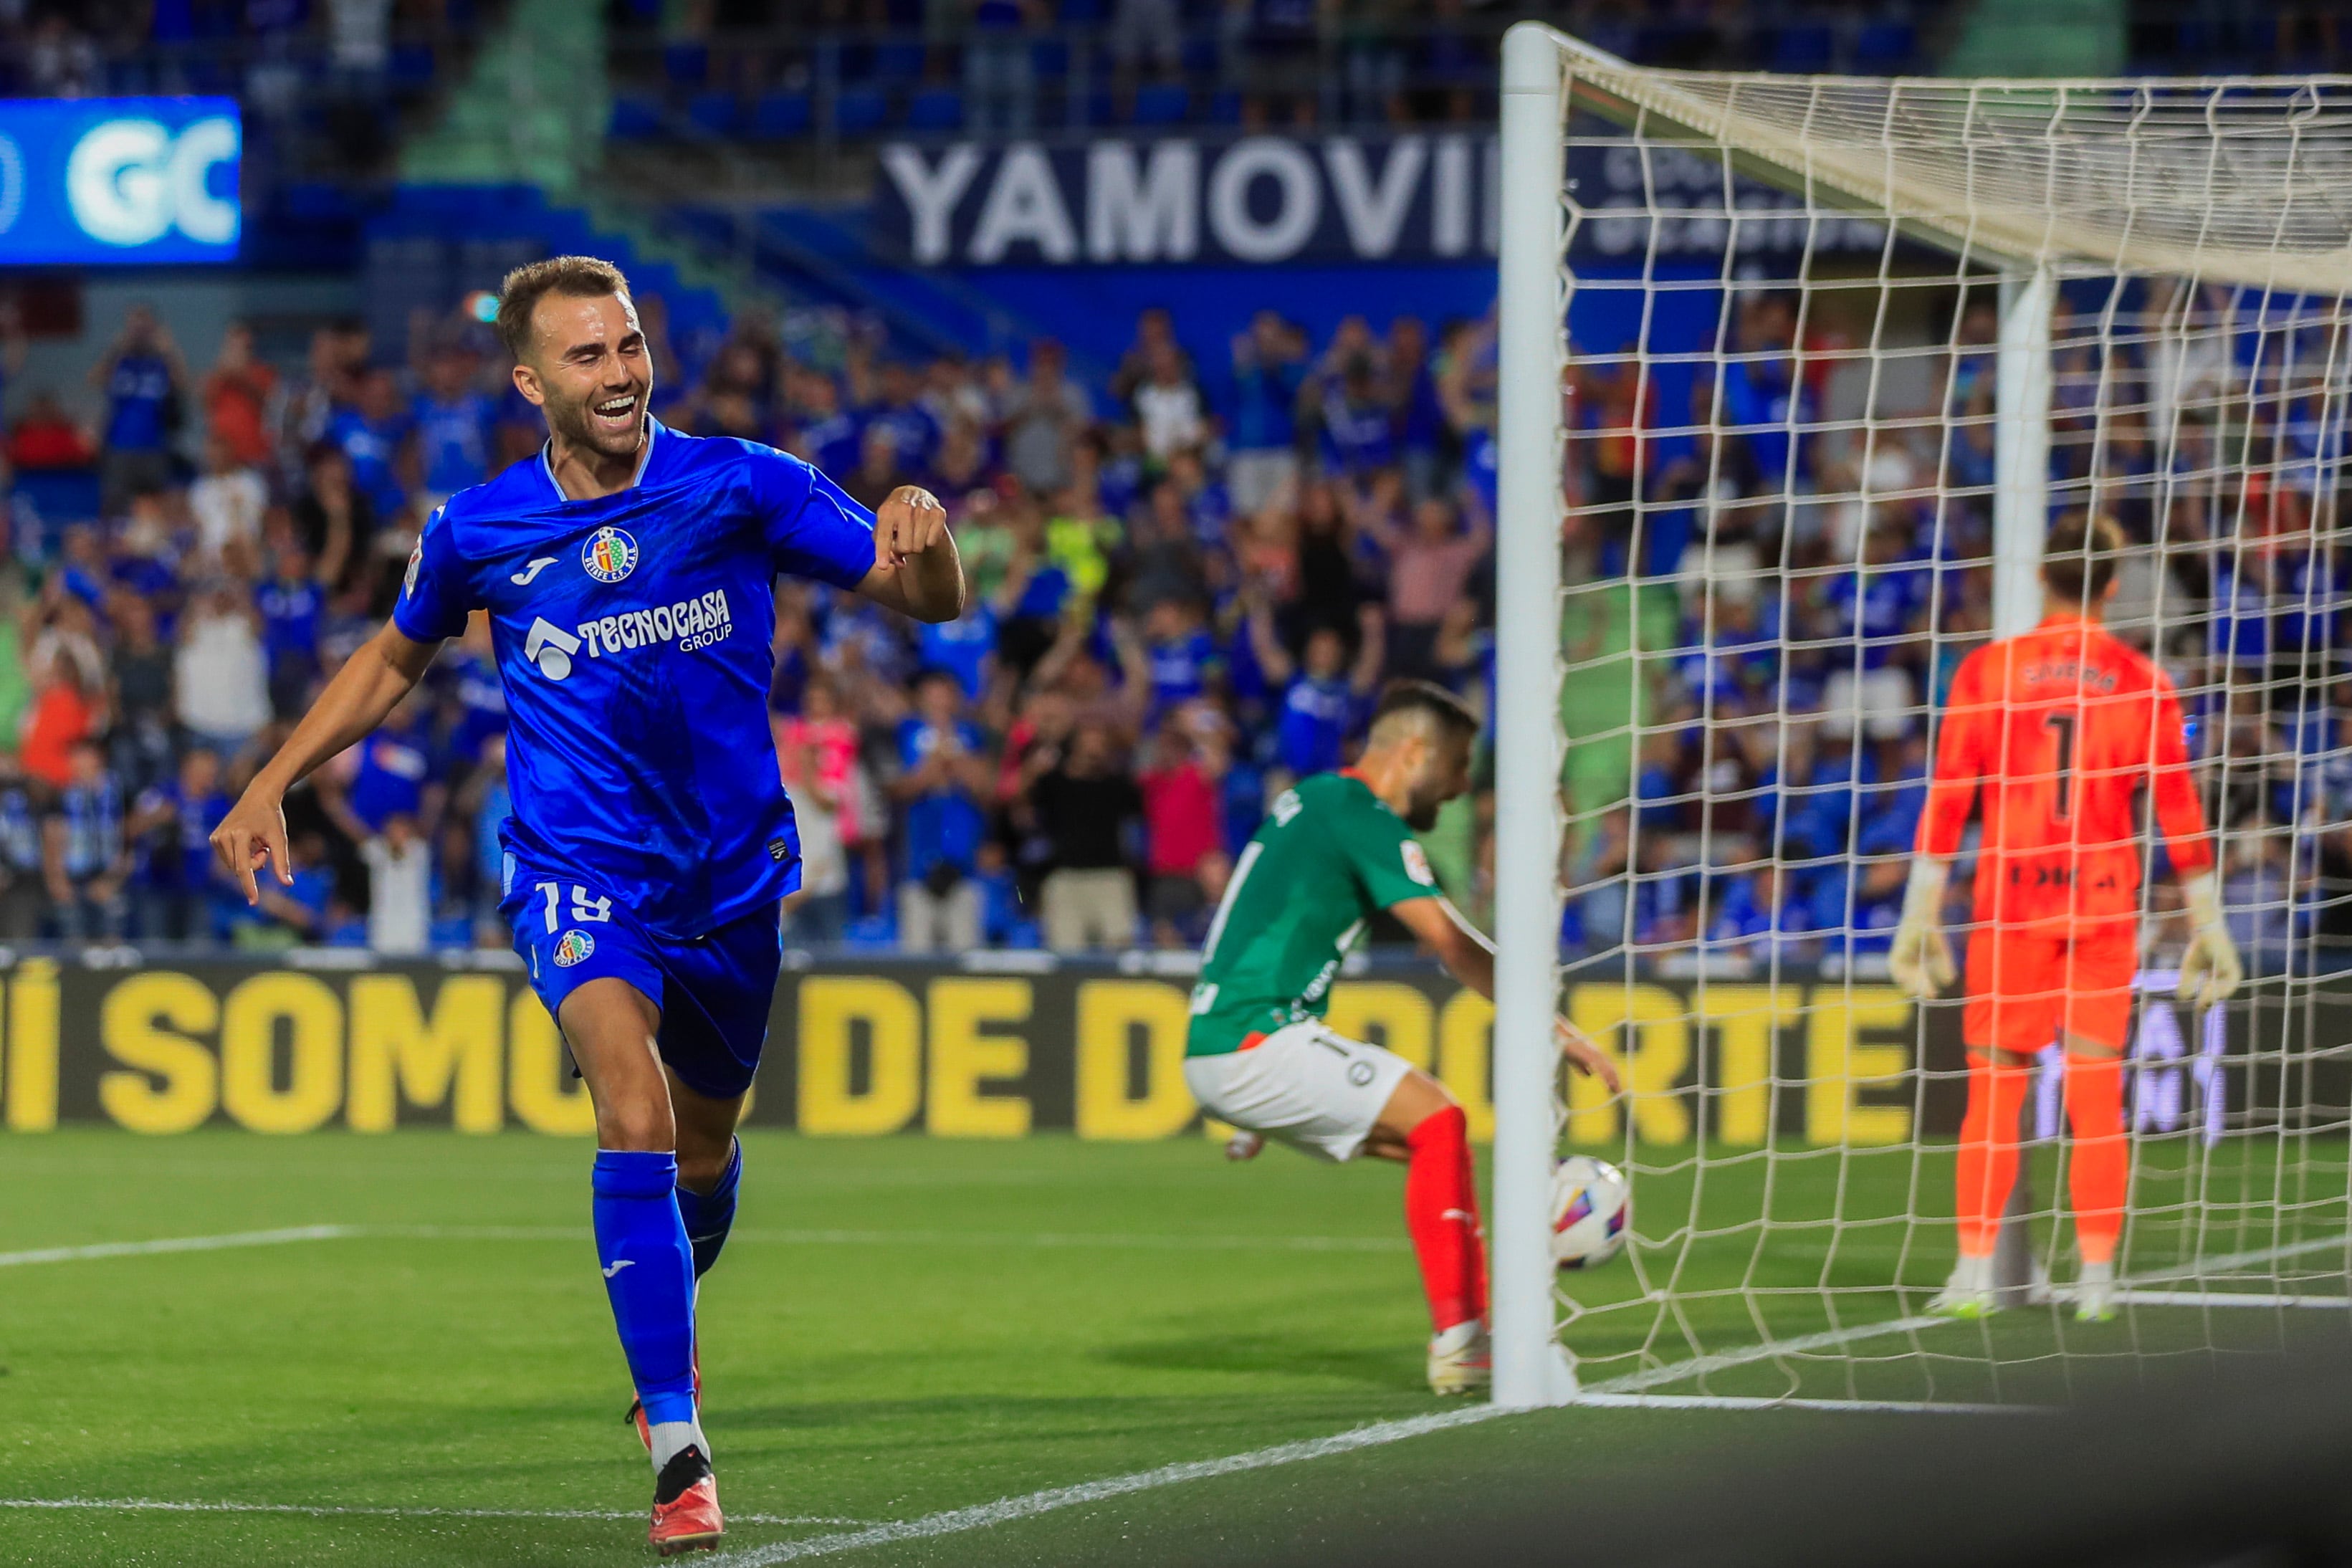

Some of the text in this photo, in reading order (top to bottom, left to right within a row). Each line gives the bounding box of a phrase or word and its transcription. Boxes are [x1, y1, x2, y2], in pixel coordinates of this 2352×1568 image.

[880, 135, 1499, 265] YAMOVI
[584, 557, 608, 580] GETAFE
[577, 588, 730, 659] TECNOCASA
[679, 623, 732, 652] GROUP
[2045, 714, 2076, 820] 1
[99, 970, 755, 1137] SOMO
[796, 975, 1033, 1138] DE
[1076, 978, 1913, 1147] DPRTE
